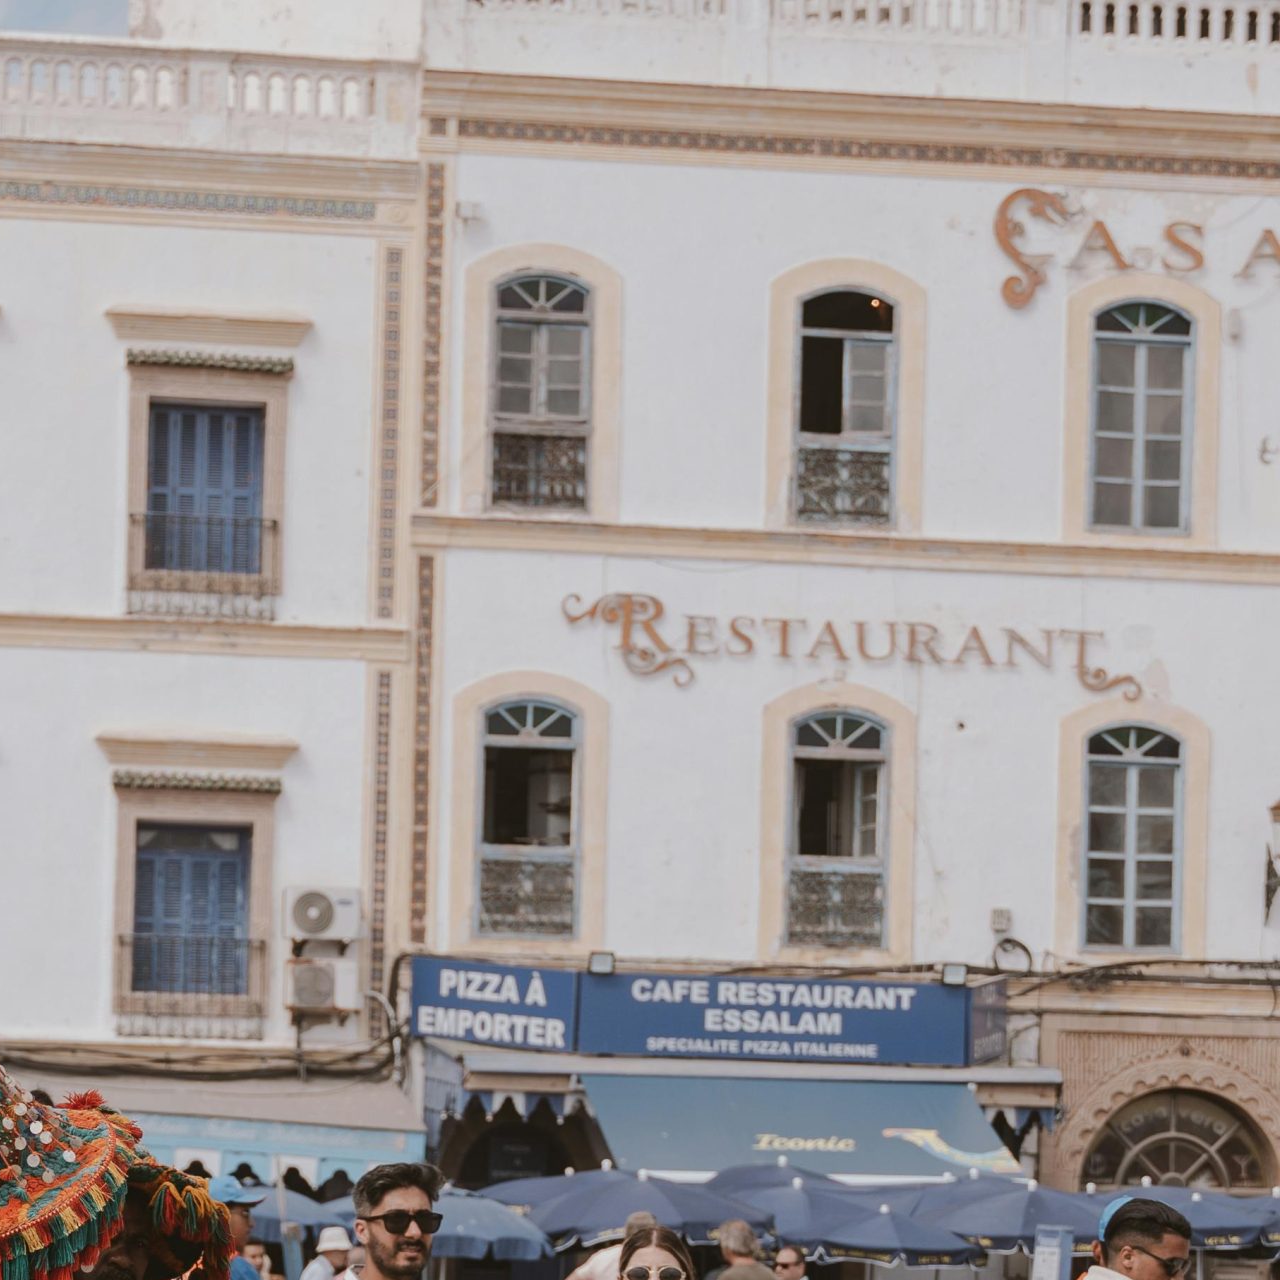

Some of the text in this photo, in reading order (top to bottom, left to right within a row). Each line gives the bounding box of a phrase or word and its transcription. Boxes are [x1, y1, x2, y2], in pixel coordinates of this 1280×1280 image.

[562, 592, 1141, 701] RESTAURANT
[439, 968, 548, 1008] PIZZA À
[631, 978, 917, 1011] CAFE RESTAURANT
[417, 1004, 566, 1049] EMPORTER
[704, 1008, 843, 1036] ESSALAM
[645, 1036, 879, 1059] SPECIALITE PIZZA ITALIENNE
